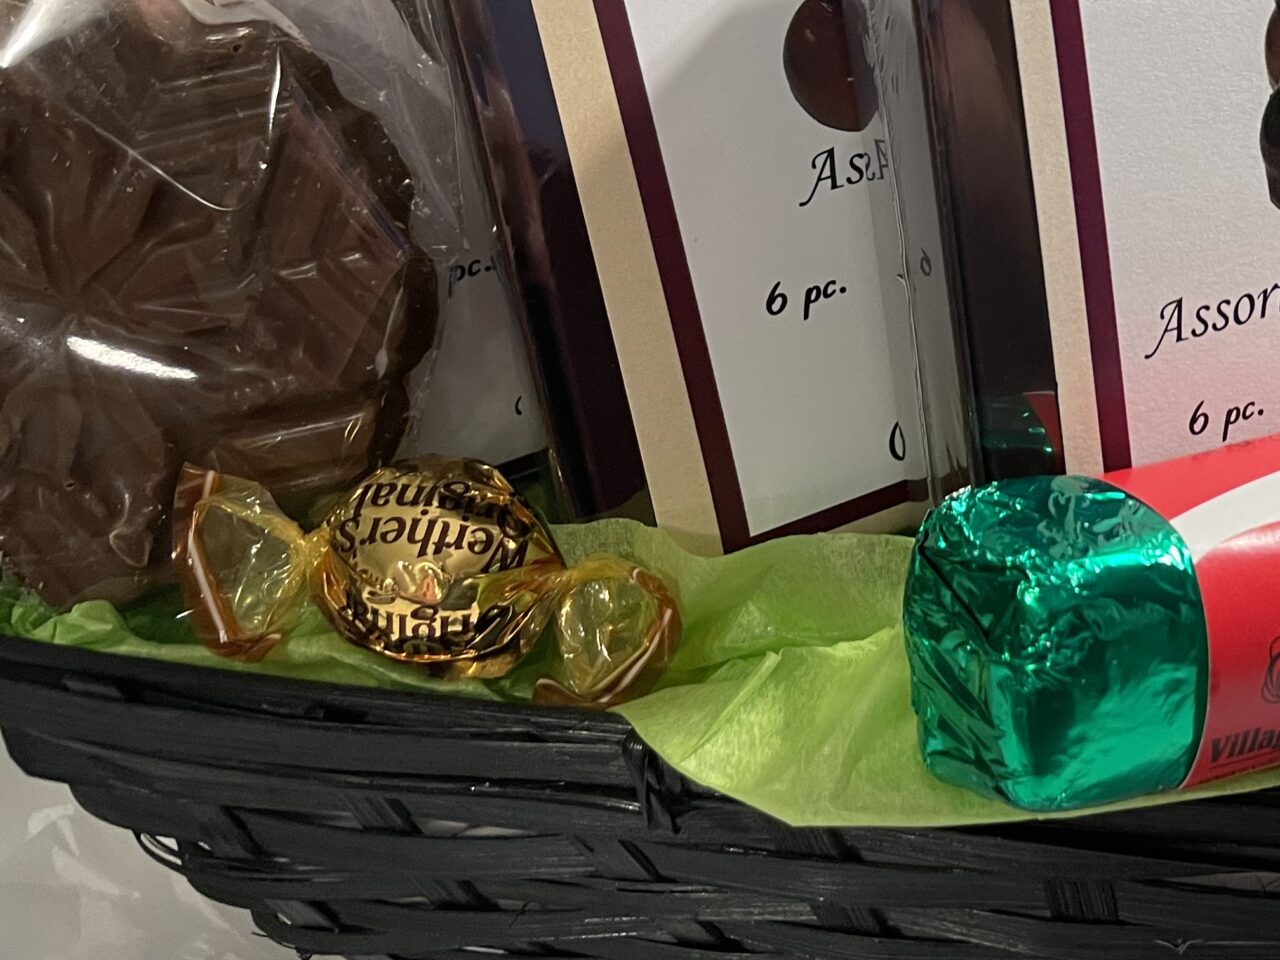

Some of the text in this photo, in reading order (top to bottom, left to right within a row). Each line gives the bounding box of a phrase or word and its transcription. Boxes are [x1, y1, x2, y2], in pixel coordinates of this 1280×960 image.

[765, 279, 847, 321] 6 pc.
[1188, 400, 1266, 442] 6 pc.
